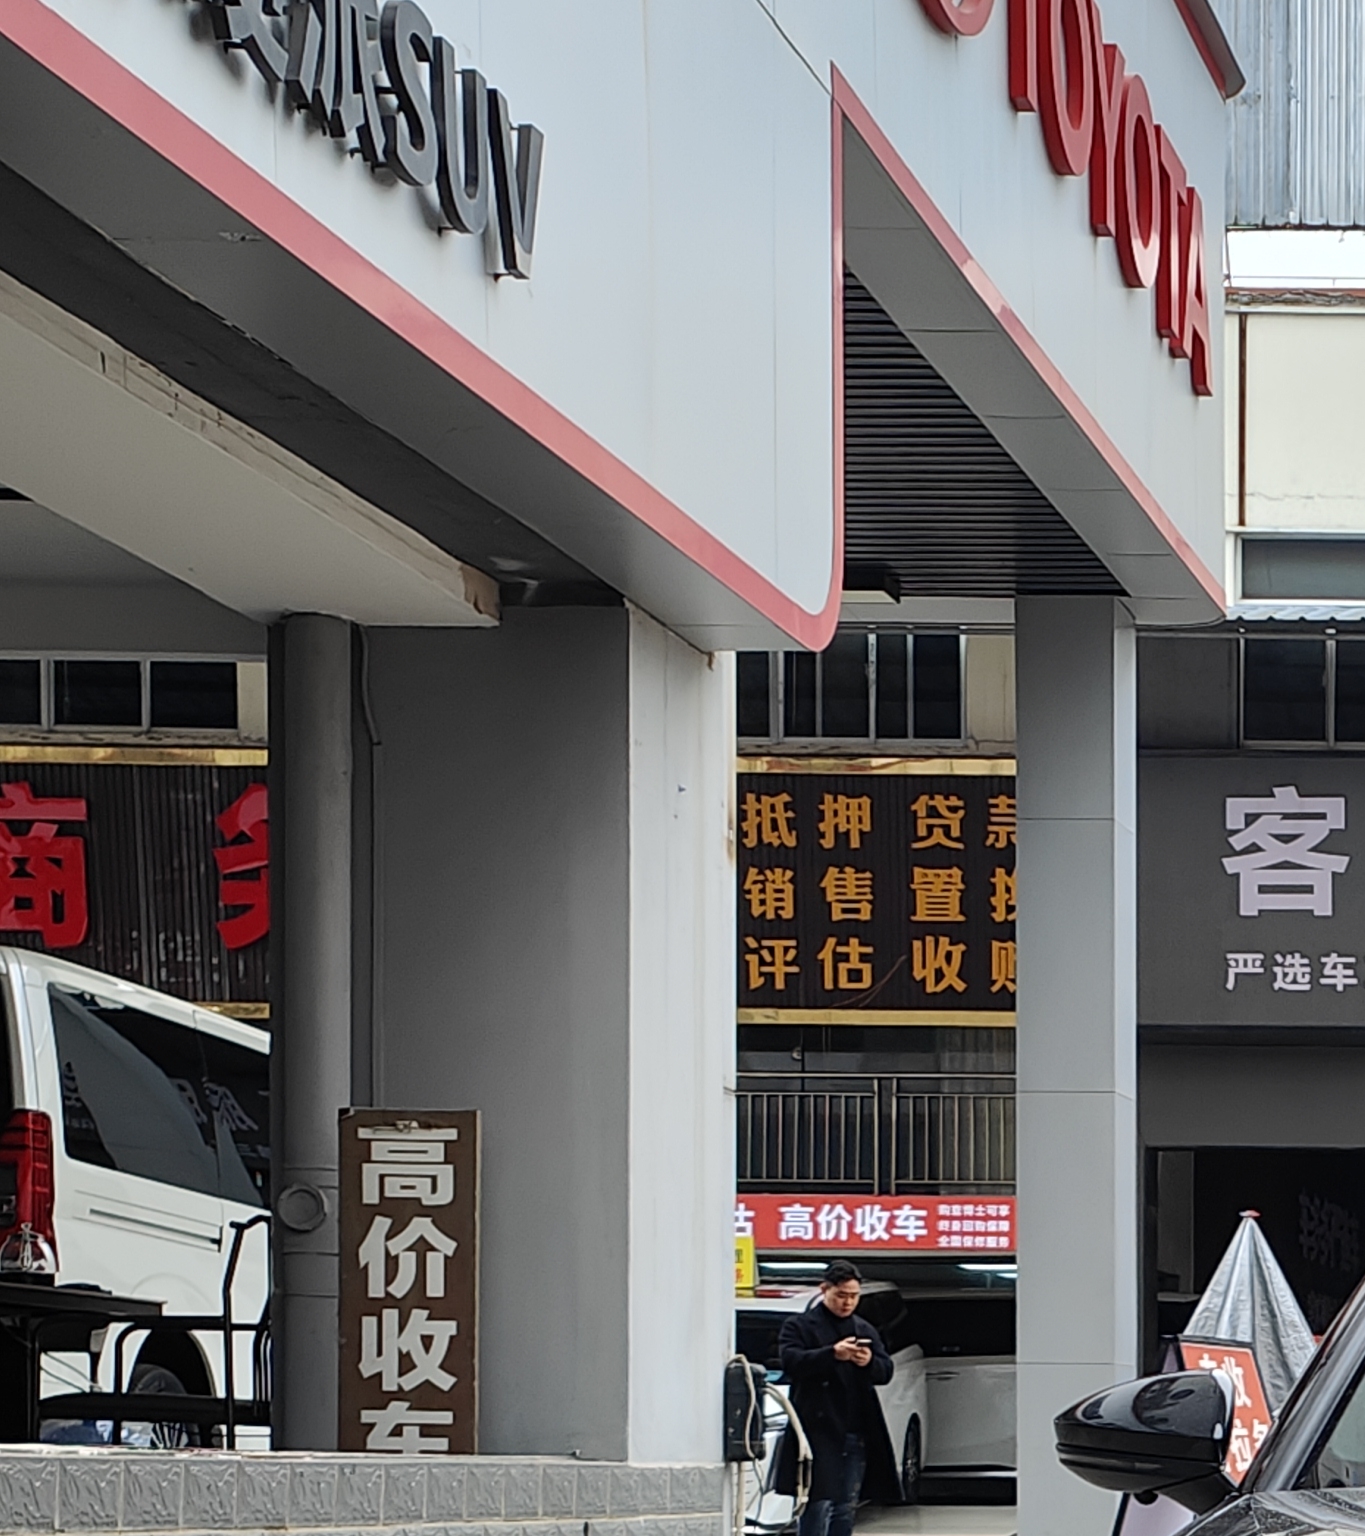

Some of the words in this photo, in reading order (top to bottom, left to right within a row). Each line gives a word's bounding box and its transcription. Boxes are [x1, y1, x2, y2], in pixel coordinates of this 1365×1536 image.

[357, 1120, 458, 1453] 高价收车
[778, 1202, 928, 1243] 高价收车
